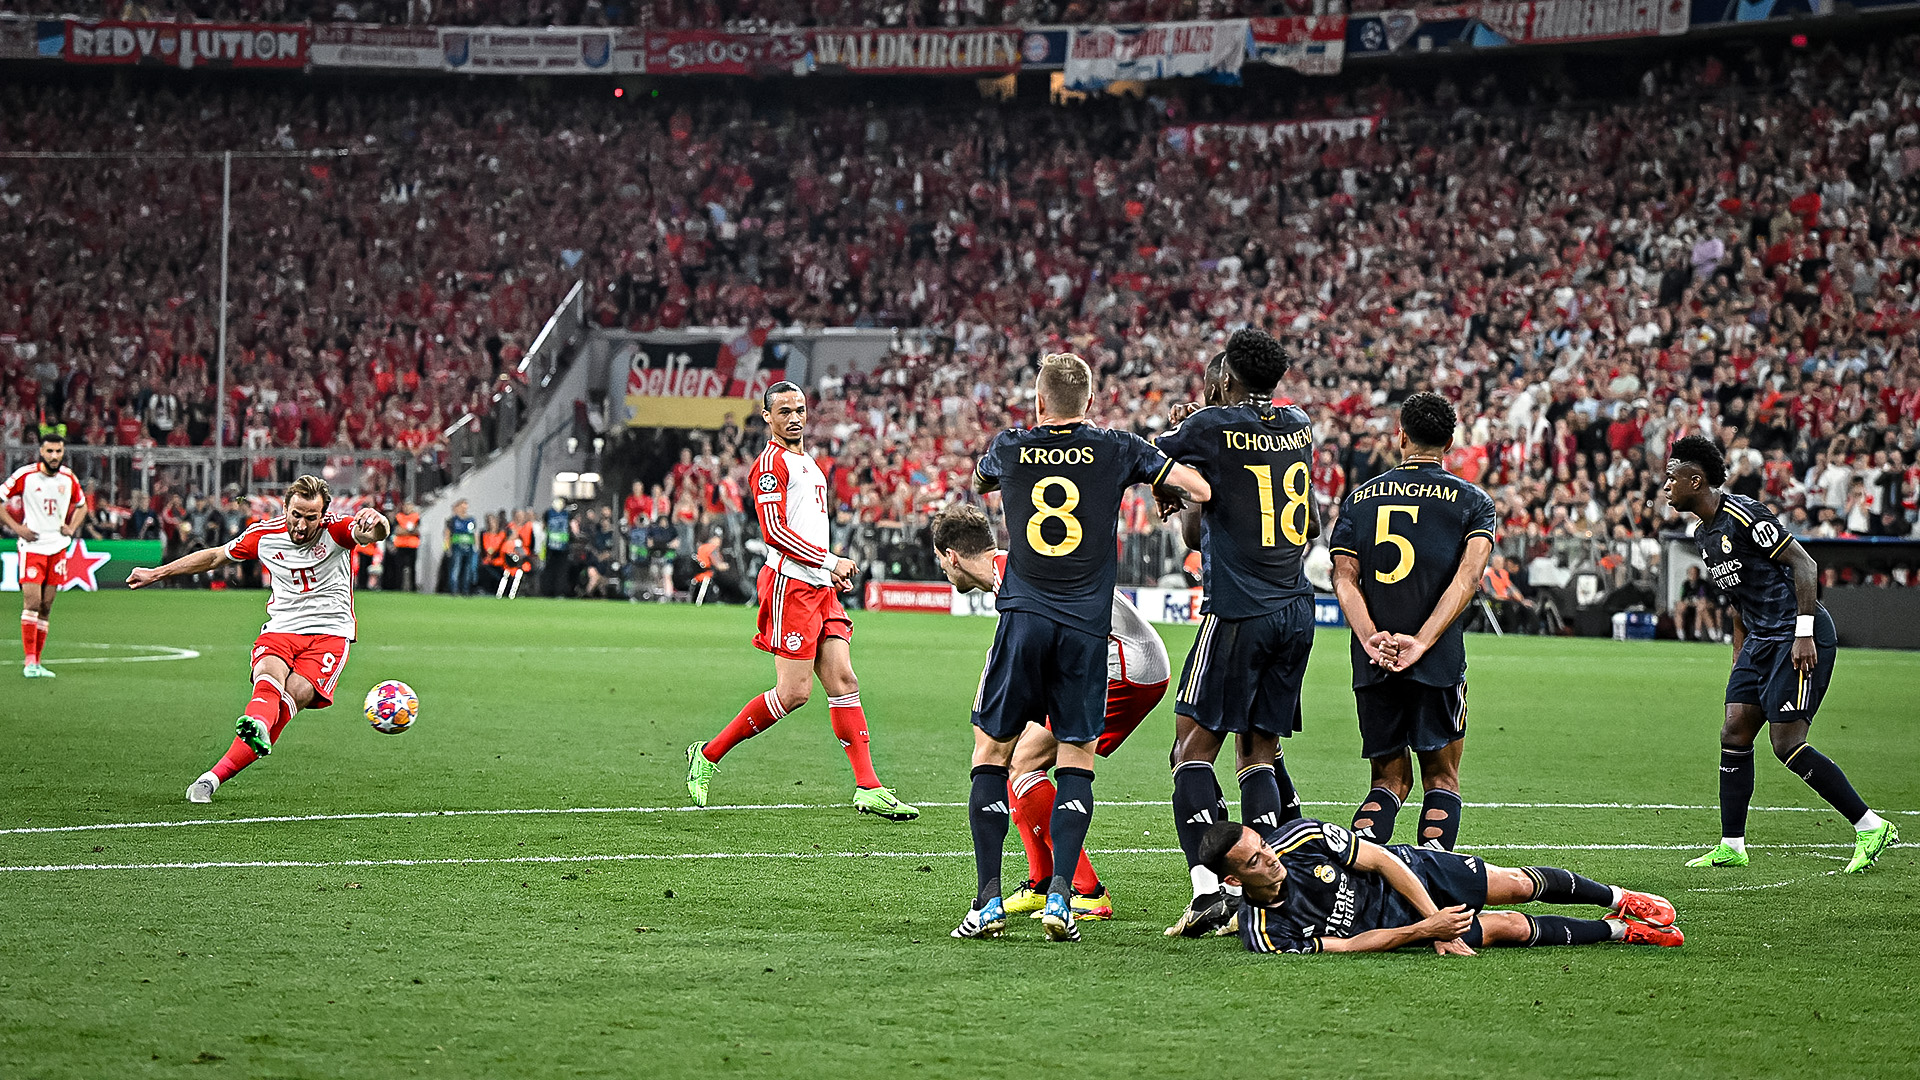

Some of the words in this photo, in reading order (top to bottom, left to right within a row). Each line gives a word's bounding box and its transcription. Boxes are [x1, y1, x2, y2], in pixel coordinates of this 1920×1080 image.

[71, 26, 300, 69] REDVLUTION
[1019, 446, 1095, 466] KROOS
[1243, 461, 1310, 547] 18
[1353, 481, 1459, 505] BELLINGHAM
[1026, 475, 1083, 557] 8
[1374, 504, 1420, 585] 5
[1752, 523, 1775, 546] hp
[1706, 558, 1742, 579] mirates
[1163, 594, 1202, 621] FedE
[320, 652, 336, 673] 9
